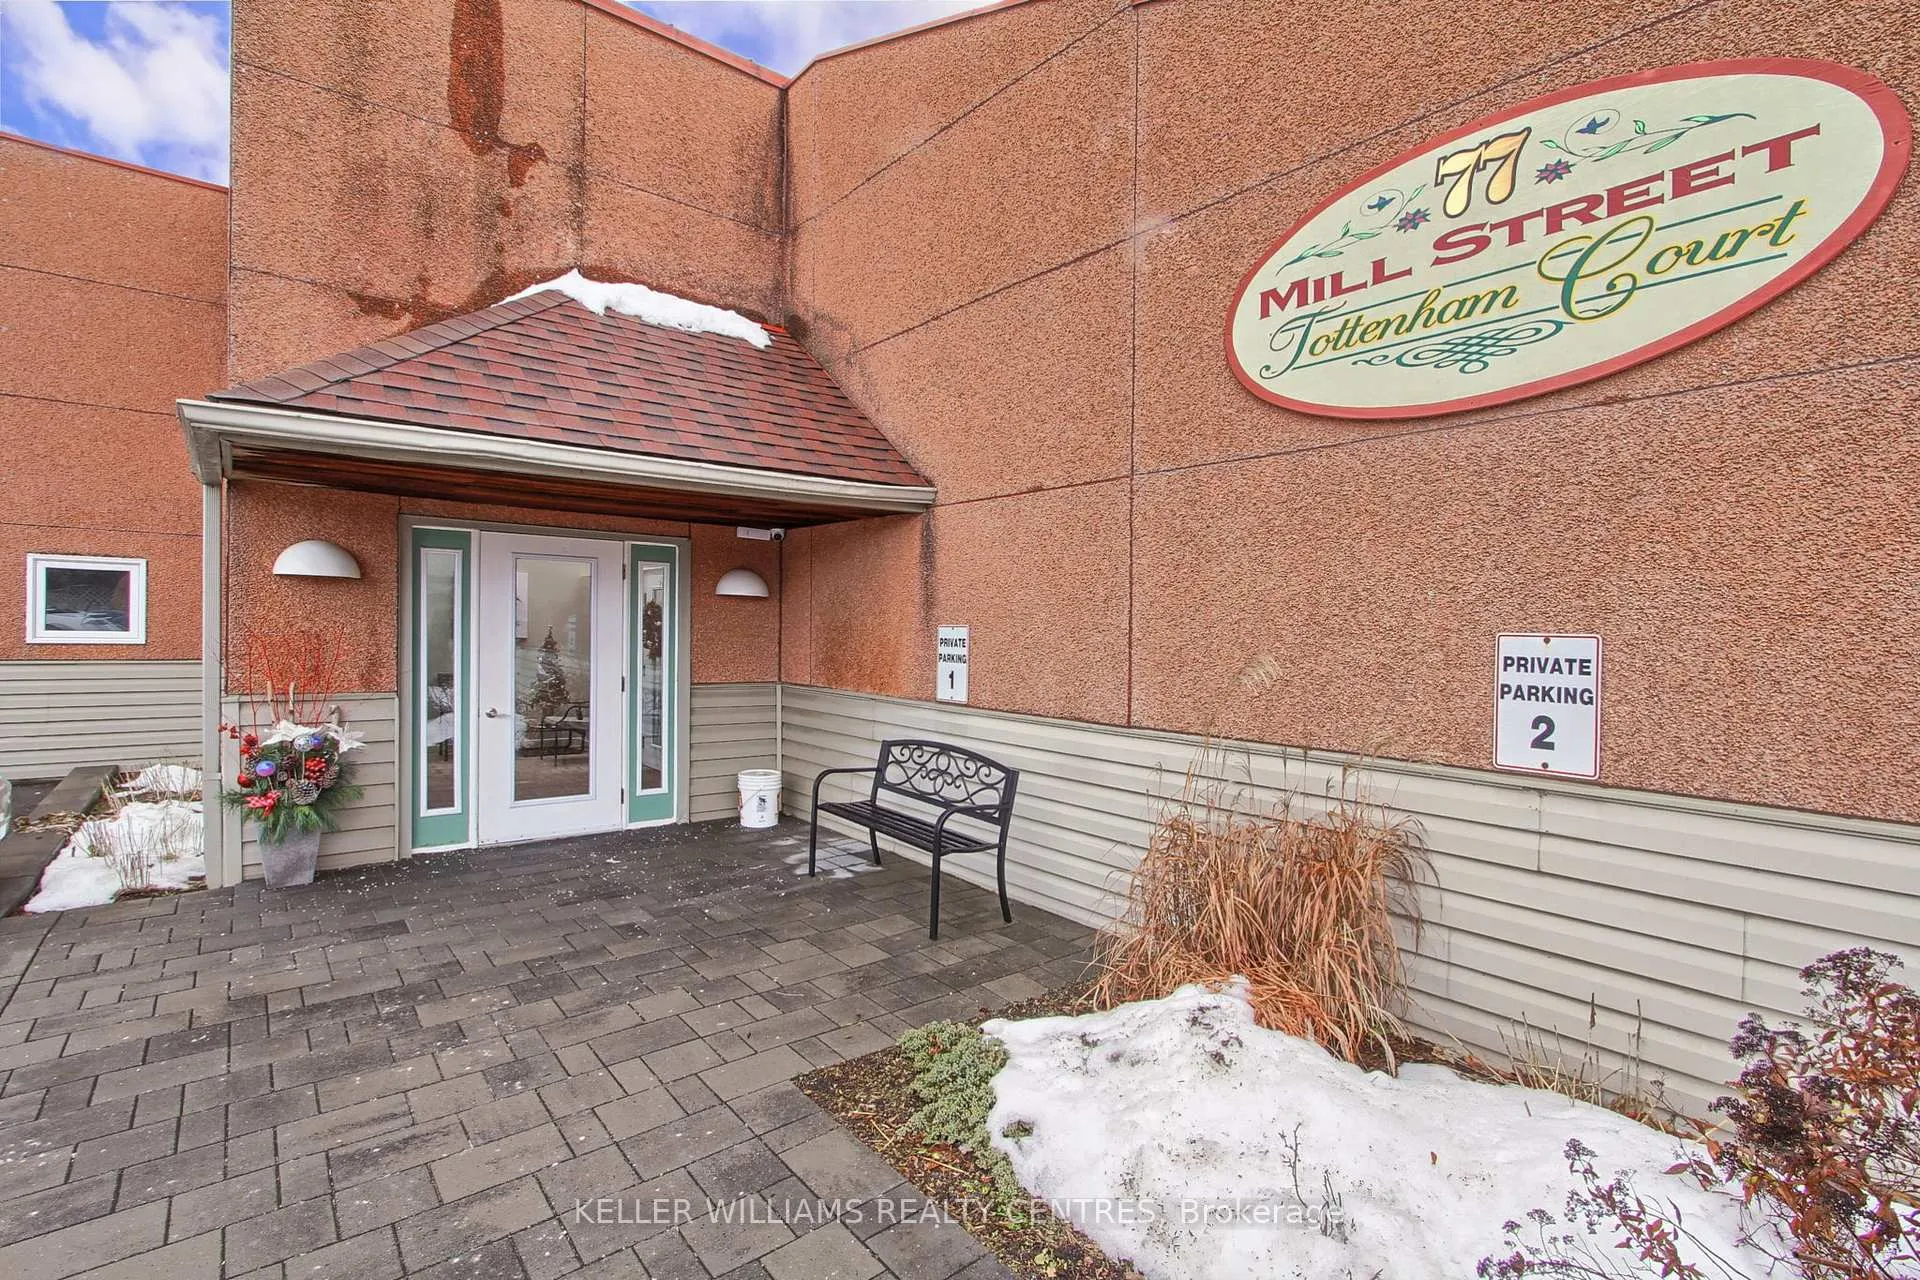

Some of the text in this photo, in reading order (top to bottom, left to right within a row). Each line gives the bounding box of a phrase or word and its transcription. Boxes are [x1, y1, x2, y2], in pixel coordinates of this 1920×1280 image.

[1435, 126, 1532, 219] 77
[1258, 123, 1822, 320] MILL STREET
[1259, 199, 1808, 380] Tottenham Court
[939, 637, 966, 648] PRIVATE
[938, 653, 967, 664] PARKING
[1503, 656, 1592, 676] PRIVATE
[948, 670, 954, 690] 1
[1500, 683, 1594, 706] PARKING
[1530, 715, 1555, 751] 2
